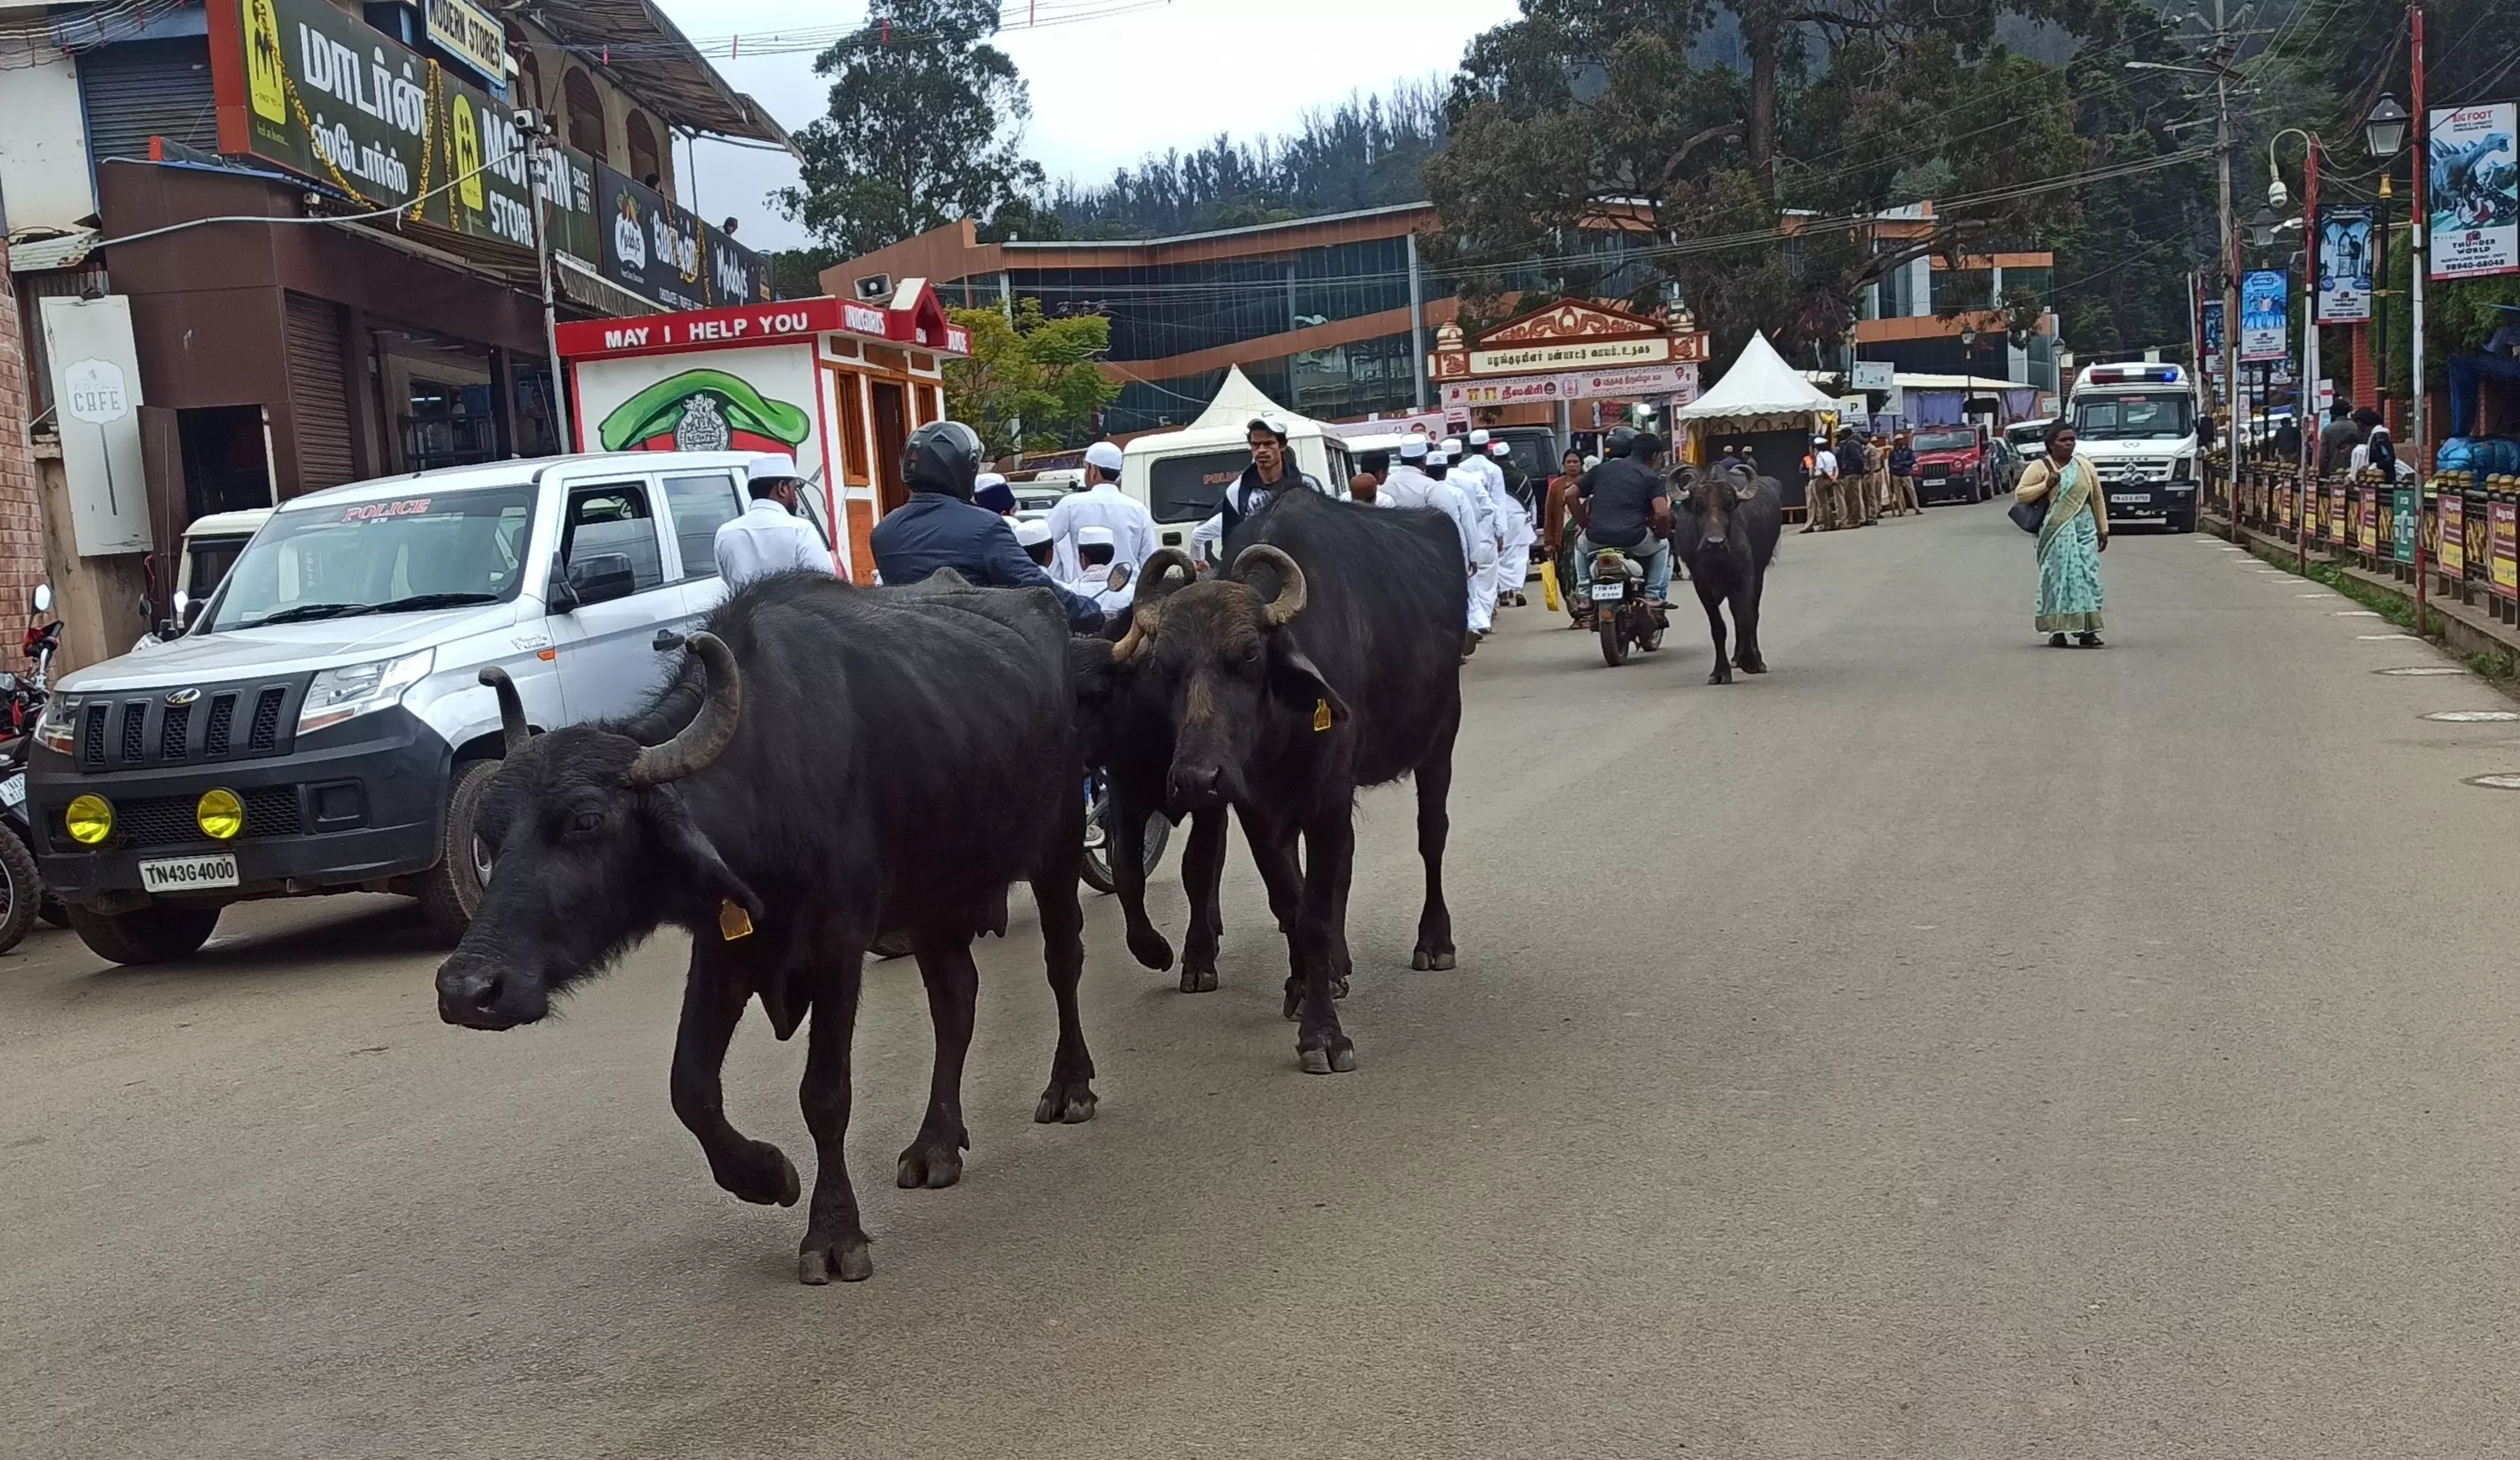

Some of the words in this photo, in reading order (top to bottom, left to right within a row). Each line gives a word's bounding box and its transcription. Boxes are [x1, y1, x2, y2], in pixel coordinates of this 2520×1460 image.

[430, 0, 466, 46] MODERN
[469, 18, 500, 69] STORES
[2467, 109, 2493, 121] FOOT
[481, 107, 572, 212] MORN
[572, 166, 591, 194] SINCE
[2452, 239, 2496, 249] THUNDER
[2457, 246, 2491, 254] WORLD
[606, 326, 649, 349] MAY
[664, 325, 671, 344] I
[689, 318, 747, 341] HELP
[758, 312, 807, 334] YOU
[73, 391, 122, 412] CAFE
[1501, 384, 1543, 400] நீலகிரி
[1203, 471, 1240, 486] POLIC
[341, 498, 431, 522] POLICE
[145, 861, 234, 884] TN43G4000
